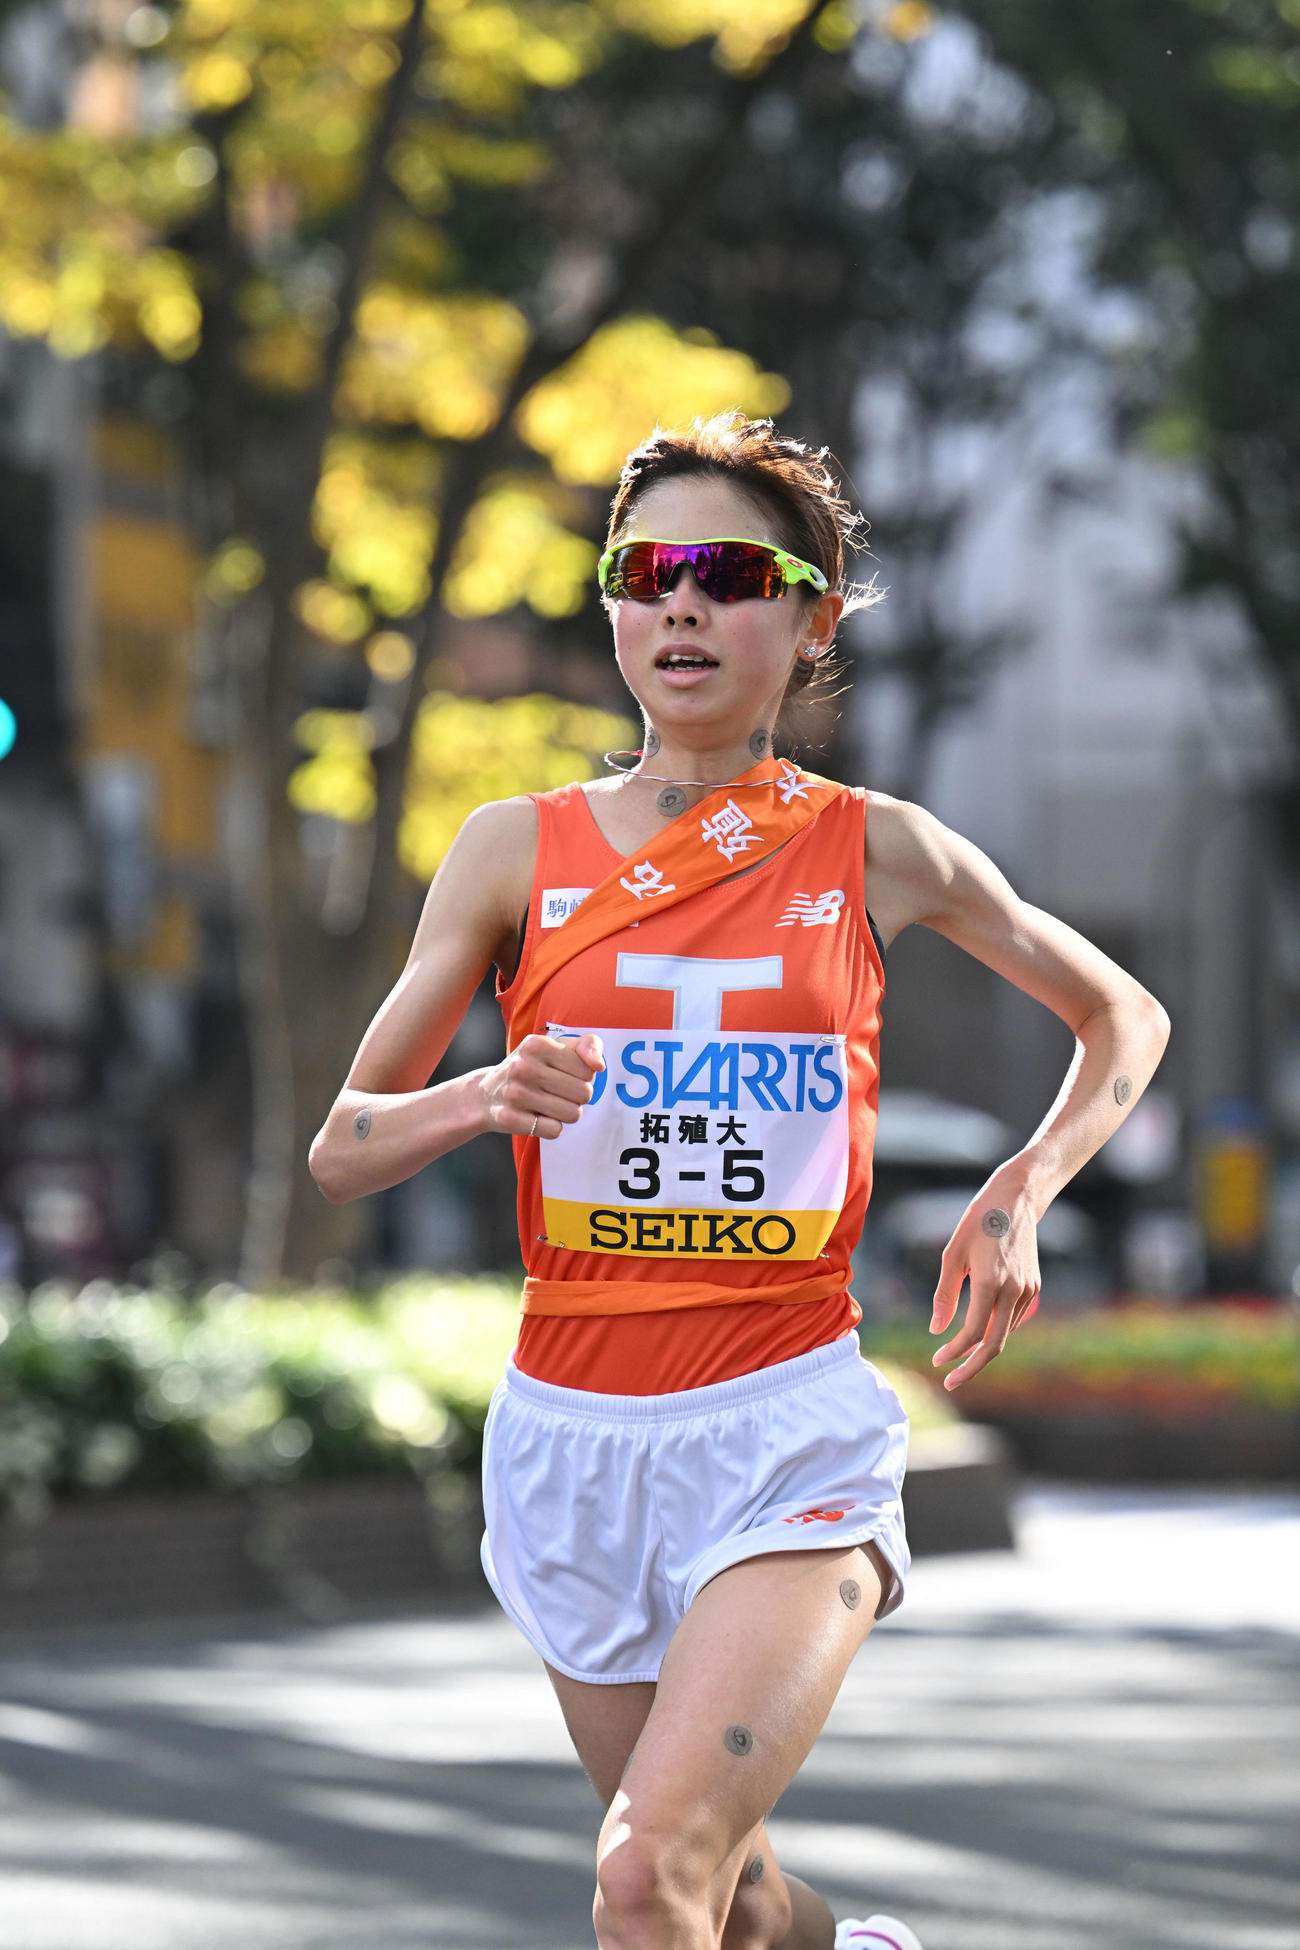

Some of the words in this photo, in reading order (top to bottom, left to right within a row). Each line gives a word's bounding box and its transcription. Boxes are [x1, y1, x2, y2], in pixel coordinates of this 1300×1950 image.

[616, 952, 783, 1031] T
[640, 1113, 747, 1146] 拓殖大
[618, 1147, 765, 1202] 3-5
[589, 1210, 796, 1255] SEIKO
